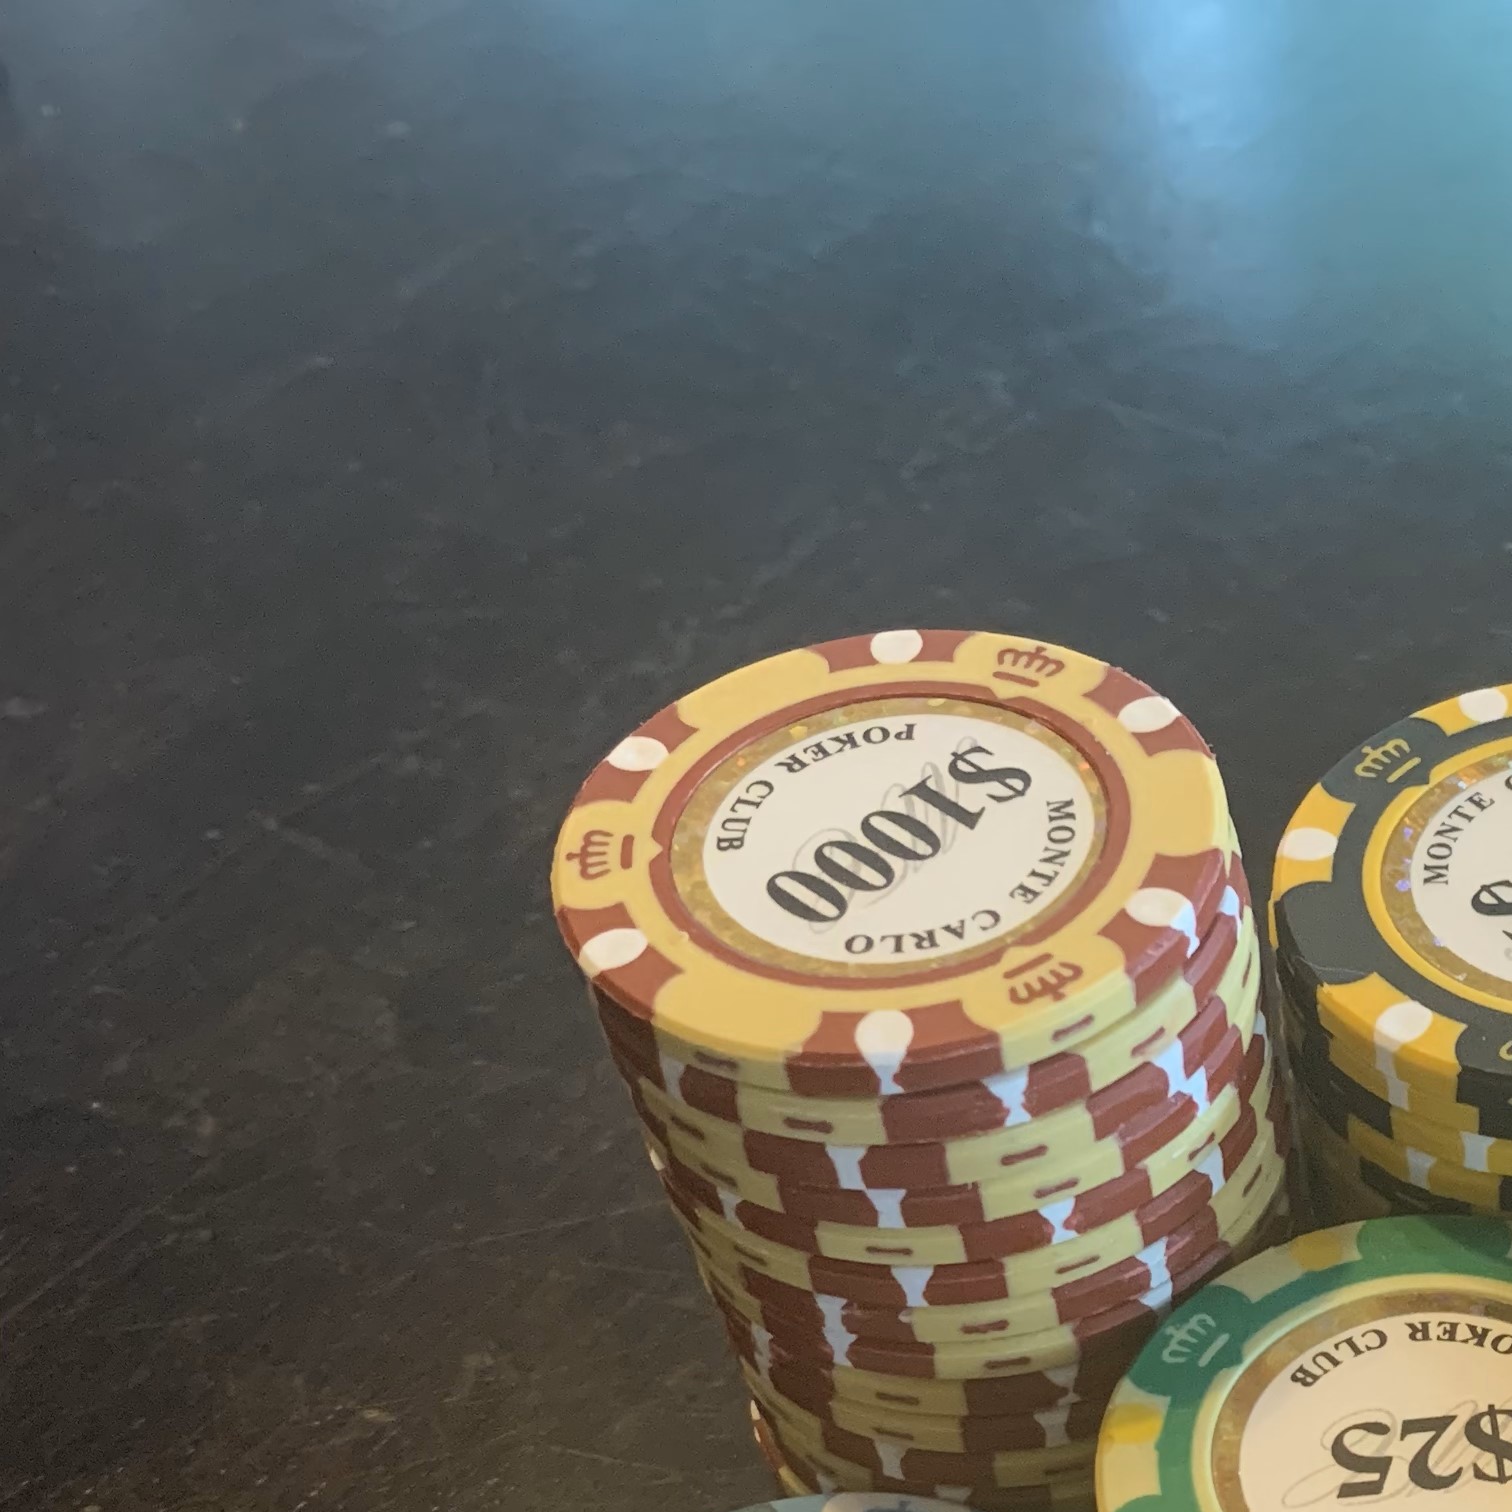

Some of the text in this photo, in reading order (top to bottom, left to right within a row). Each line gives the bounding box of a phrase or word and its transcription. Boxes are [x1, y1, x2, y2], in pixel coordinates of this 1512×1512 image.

[716, 723, 918, 852] POKER CLUB
[766, 746, 1032, 923] $1000
[1423, 791, 1496, 885] MONTE
[845, 799, 1076, 955] MONTE CARLO
[1290, 1328, 1388, 1387] CLUB
